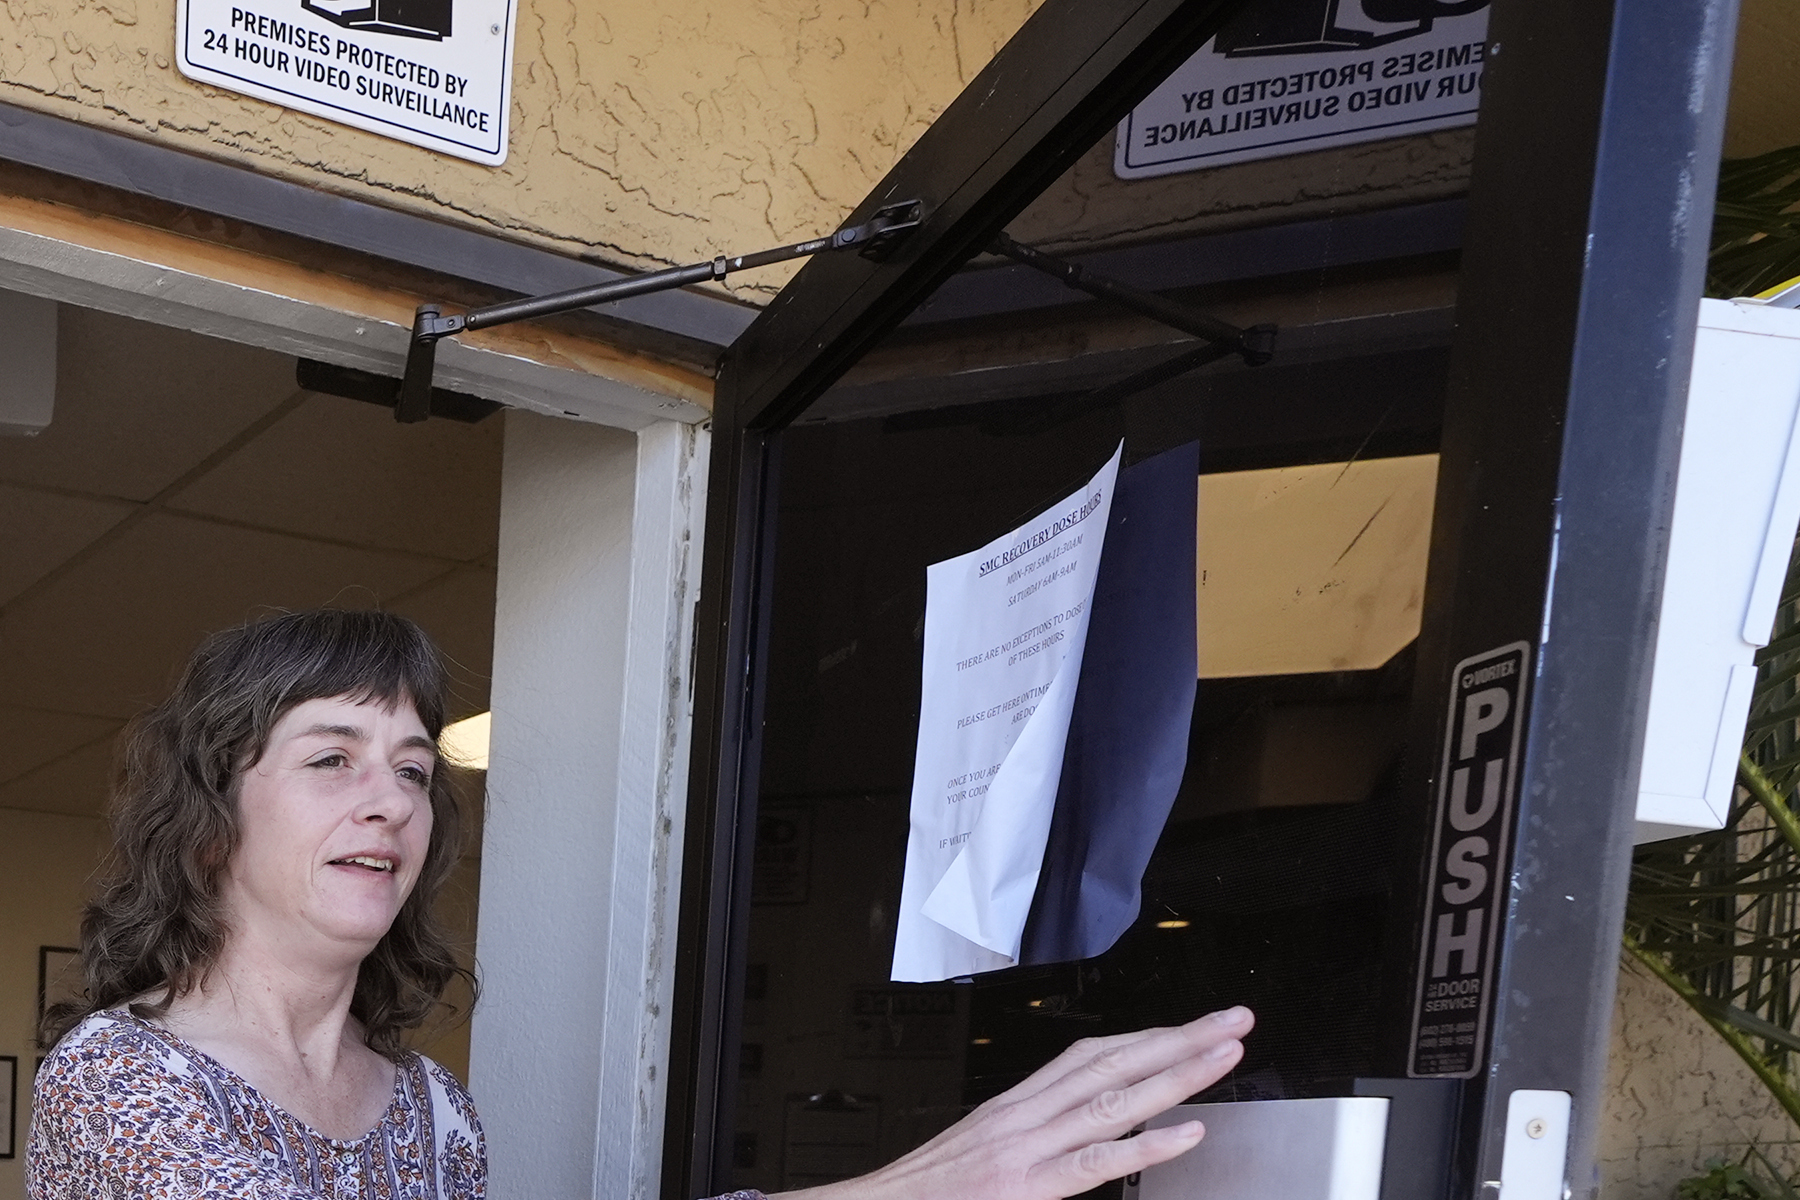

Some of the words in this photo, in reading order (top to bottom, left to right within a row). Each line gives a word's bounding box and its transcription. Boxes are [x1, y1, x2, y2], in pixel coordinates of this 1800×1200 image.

[231, 6, 331, 56] PREMISES
[336, 43, 439, 90] PROTECTED
[445, 73, 469, 98] BY
[203, 29, 229, 54] 24
[234, 40, 290, 74] HOUR
[294, 56, 350, 91] VIDEO
[356, 75, 489, 133] SURVEILLANCE
[979, 558, 1002, 577] SMC
[1002, 527, 1052, 566] RECOVERY
[1052, 511, 1079, 538] DOSE
[1079, 488, 1103, 520] HOURS
[1006, 563, 1038, 587] MON-FRI
[1008, 580, 1044, 607] SATURDAY
[1043, 561, 1077, 587] 6AM-9AM
[956, 650, 984, 672] THERE
[984, 647, 1000, 662] ARE
[1001, 641, 1012, 655] NO
[1012, 620, 1054, 650] EXCEPTIONS
[1053, 612, 1064, 626] TO
[1007, 652, 1017, 667] OF
[1018, 643, 1041, 662] THESE
[1041, 630, 1065, 652] HOURS
[956, 711, 986, 729] PLEASE
[986, 705, 1002, 718] GET
[1001, 696, 1021, 713] HERE
[1011, 711, 1024, 725] ARE
[947, 773, 967, 789] ONCE
[969, 769, 986, 782] YOU
[947, 790, 967, 805] YOUR
[938, 838, 948, 850] IF
[1432, 687, 1511, 979] PUSH
[1425, 996, 1478, 1012] SERVICE
[1438, 979, 1481, 997] DOOR
